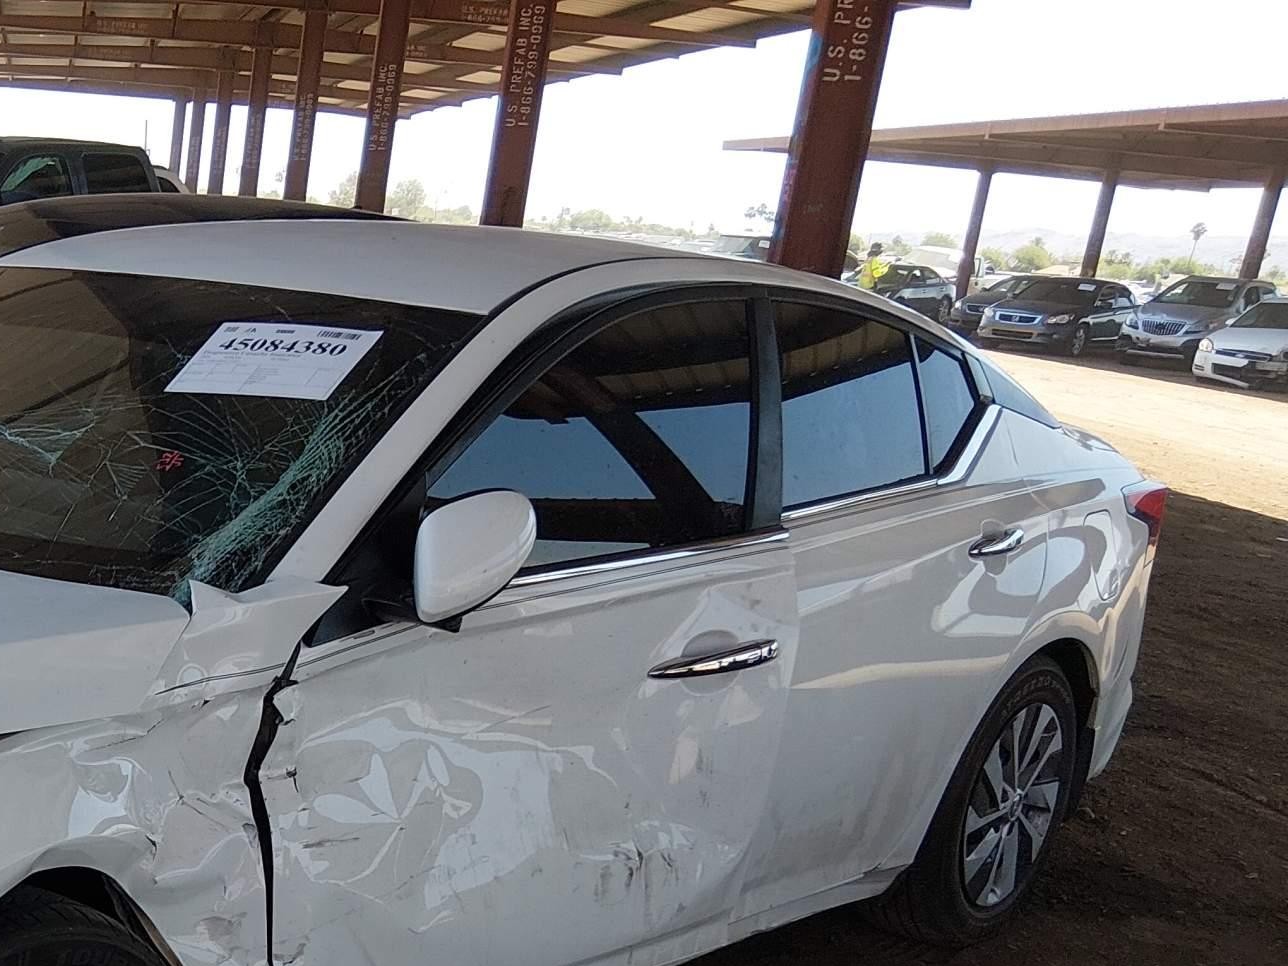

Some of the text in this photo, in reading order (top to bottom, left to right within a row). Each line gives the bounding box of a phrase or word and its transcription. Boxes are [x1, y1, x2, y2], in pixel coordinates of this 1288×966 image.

[510, 38, 528, 92] PREFAB
[822, 39, 848, 81] U.S.
[219, 337, 347, 357] 45084380
